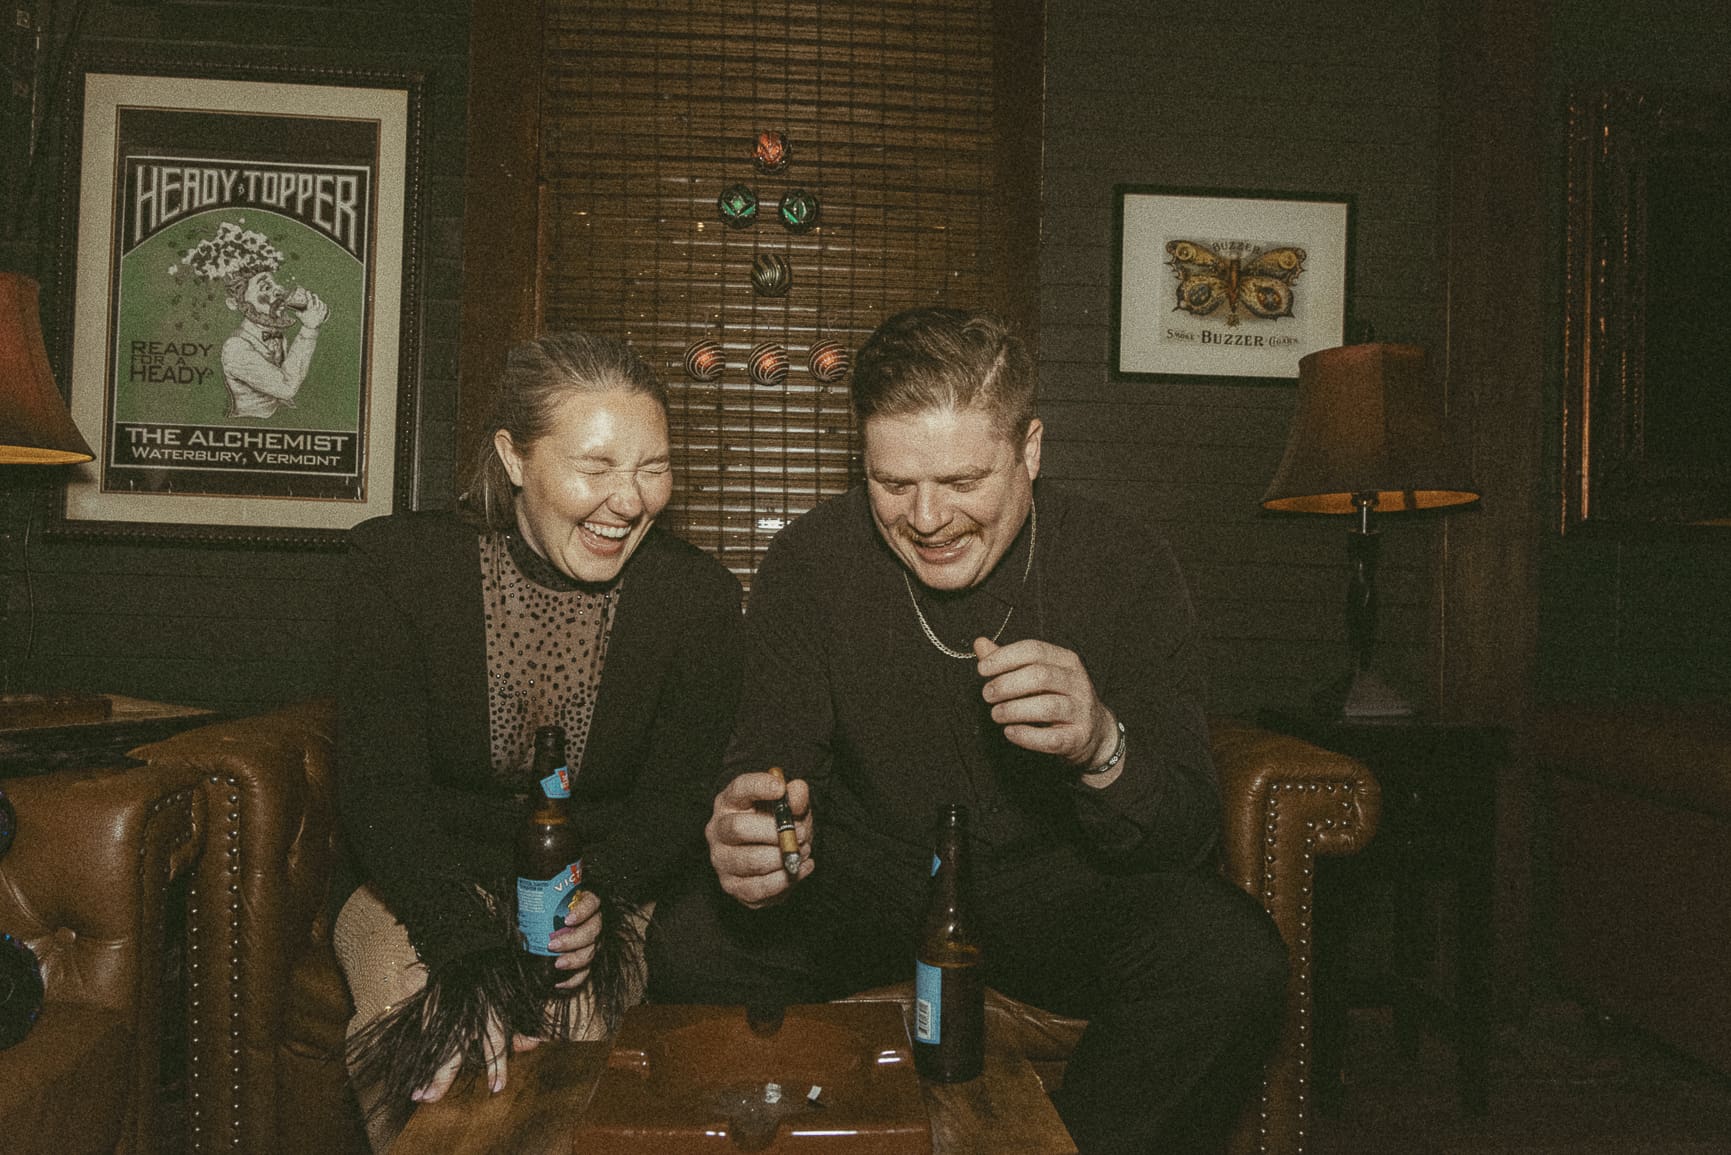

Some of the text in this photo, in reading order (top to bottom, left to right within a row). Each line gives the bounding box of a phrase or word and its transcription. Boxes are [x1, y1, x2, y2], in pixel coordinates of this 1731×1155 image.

[134, 165, 358, 254] HEADY TOPPER
[1201, 330, 1264, 347] BUZZER
[131, 340, 213, 357] READY
[131, 354, 186, 366] FOR A
[125, 427, 349, 451] THE ALCHEMIST
[131, 446, 341, 466] WATERBURY, VERMONT
